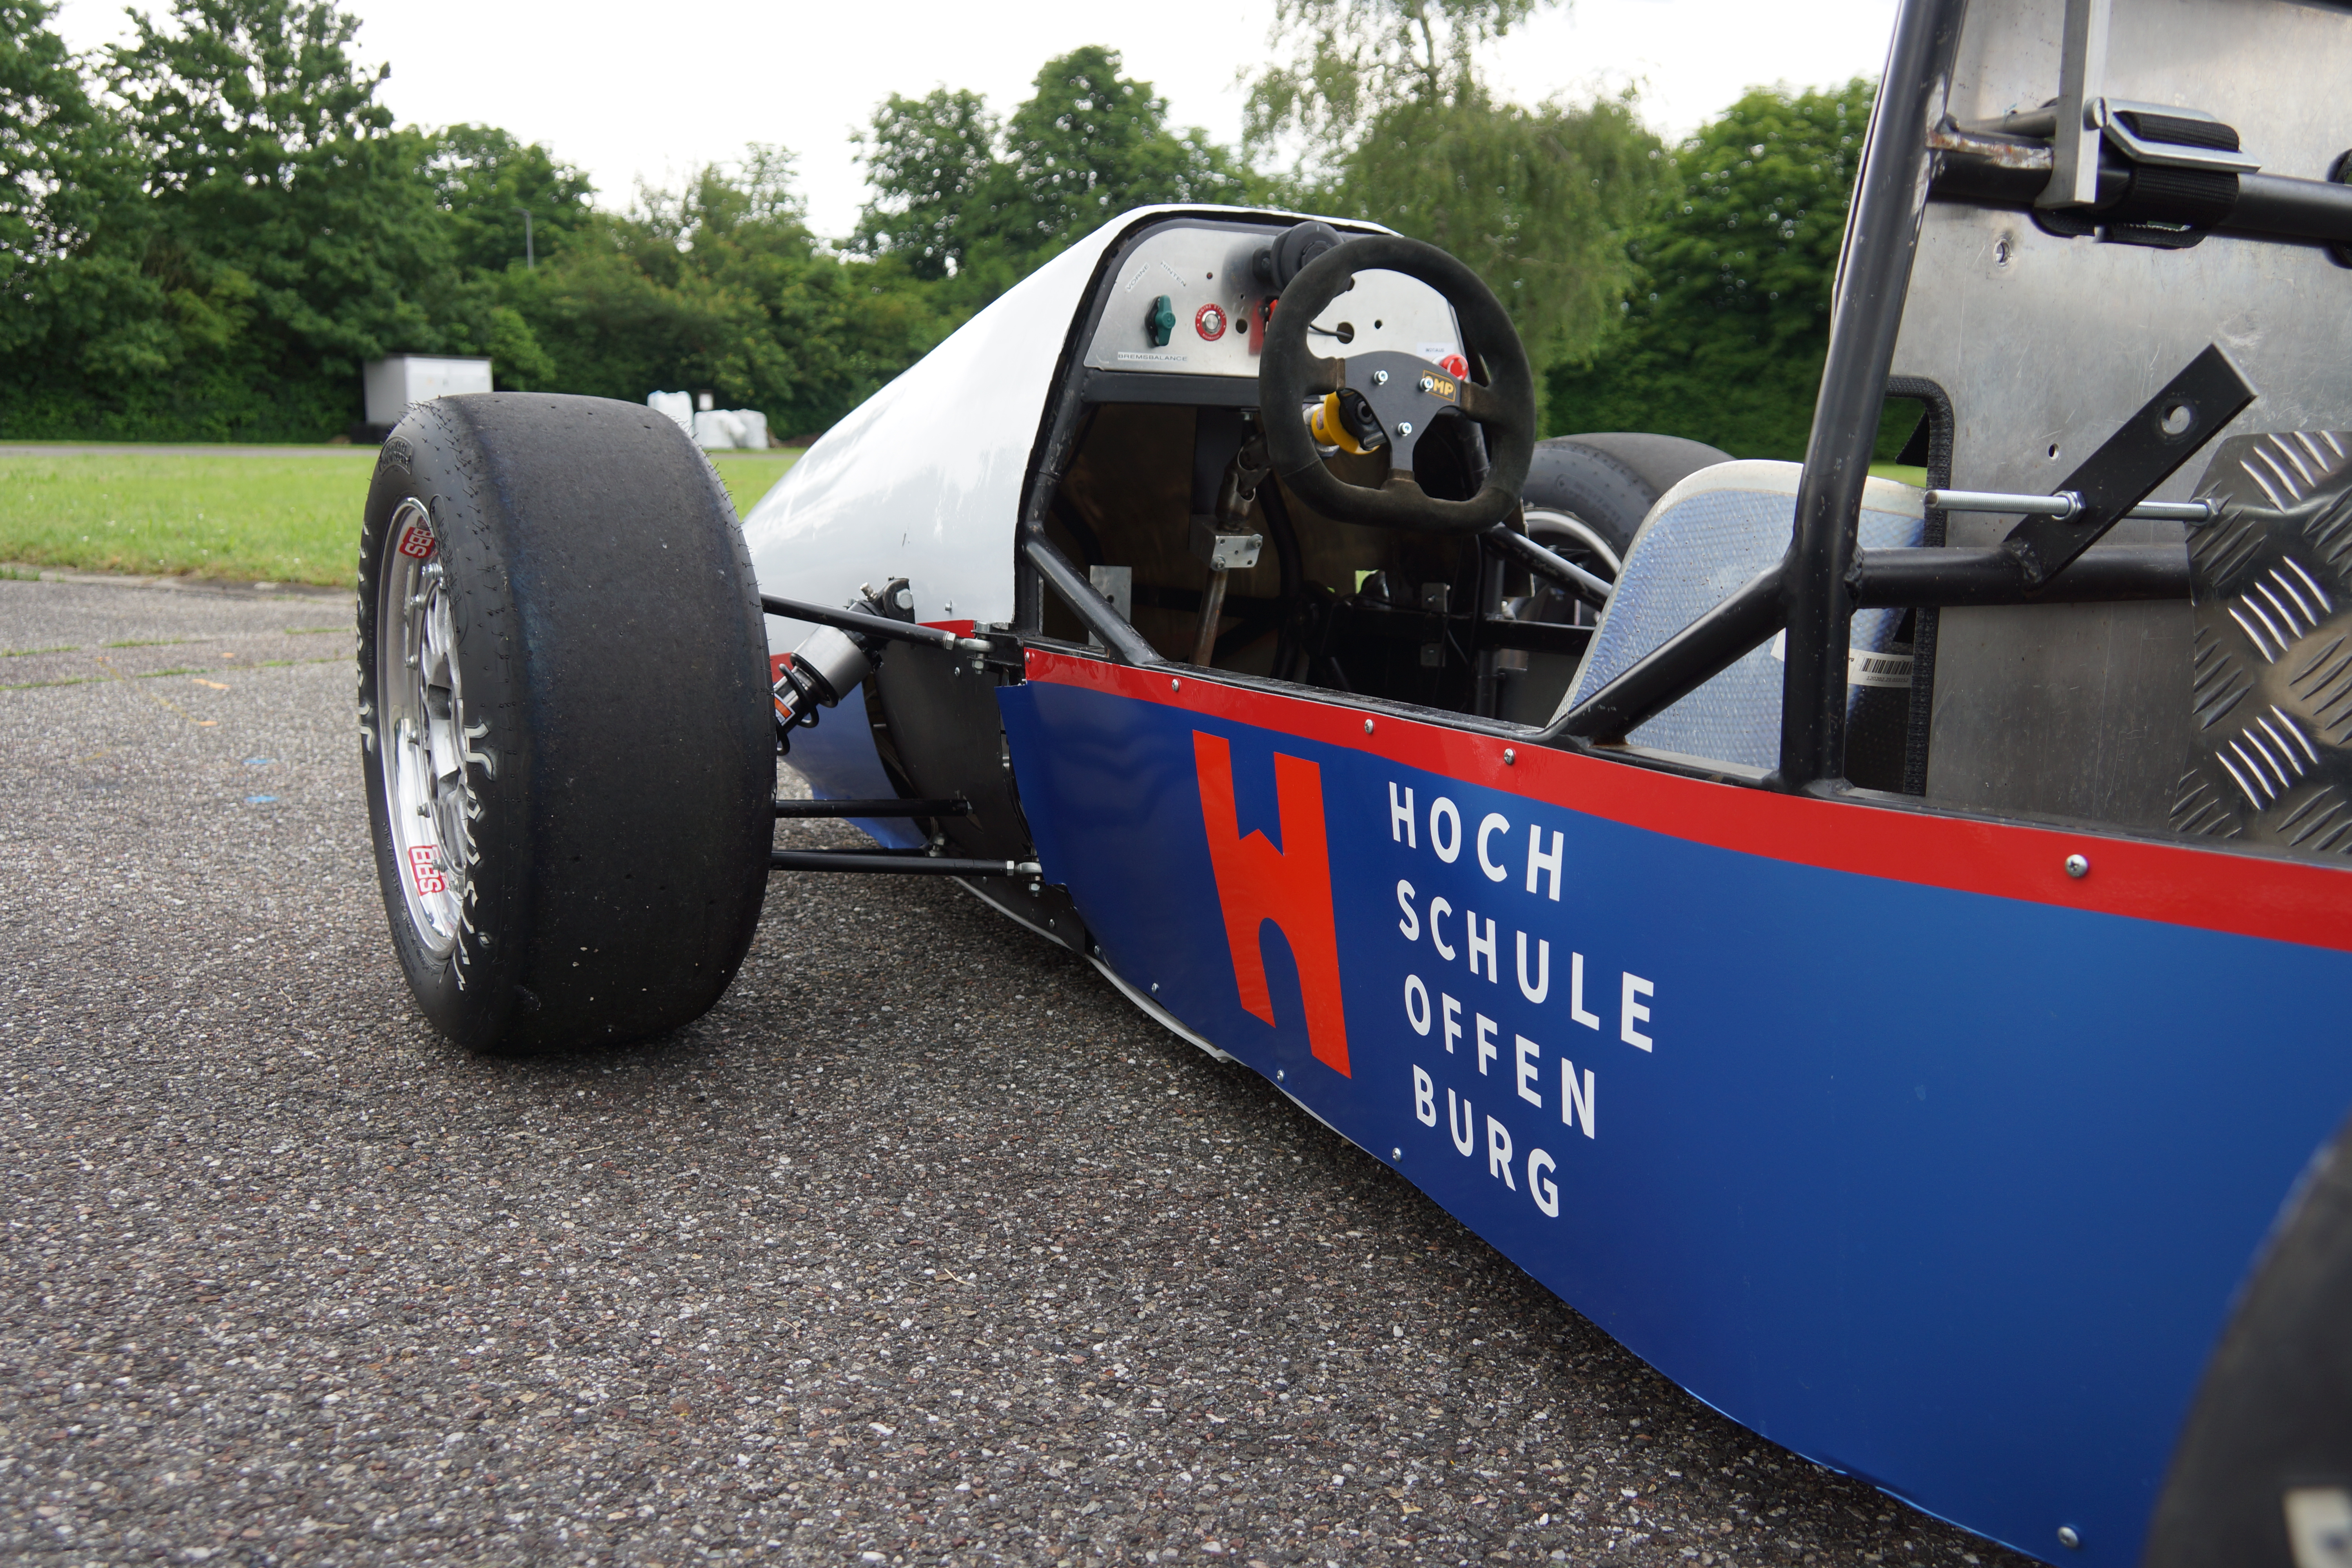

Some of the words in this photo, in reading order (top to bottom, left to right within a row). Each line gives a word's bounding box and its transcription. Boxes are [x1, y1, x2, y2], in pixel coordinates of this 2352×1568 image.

[1126, 263, 1149, 289] VORNE
[1160, 261, 1186, 287] HINTEN
[1197, 304, 1211, 319] ENGINE
[1214, 305, 1226, 318] START
[1425, 375, 1454, 396] MP
[1389, 781, 1564, 902] HOCH
[411, 848, 442, 892] BBS
[1397, 879, 1654, 1053] SCHULE
[1404, 974, 1595, 1140] OFFEN
[1412, 1063, 1559, 1218] BURG
